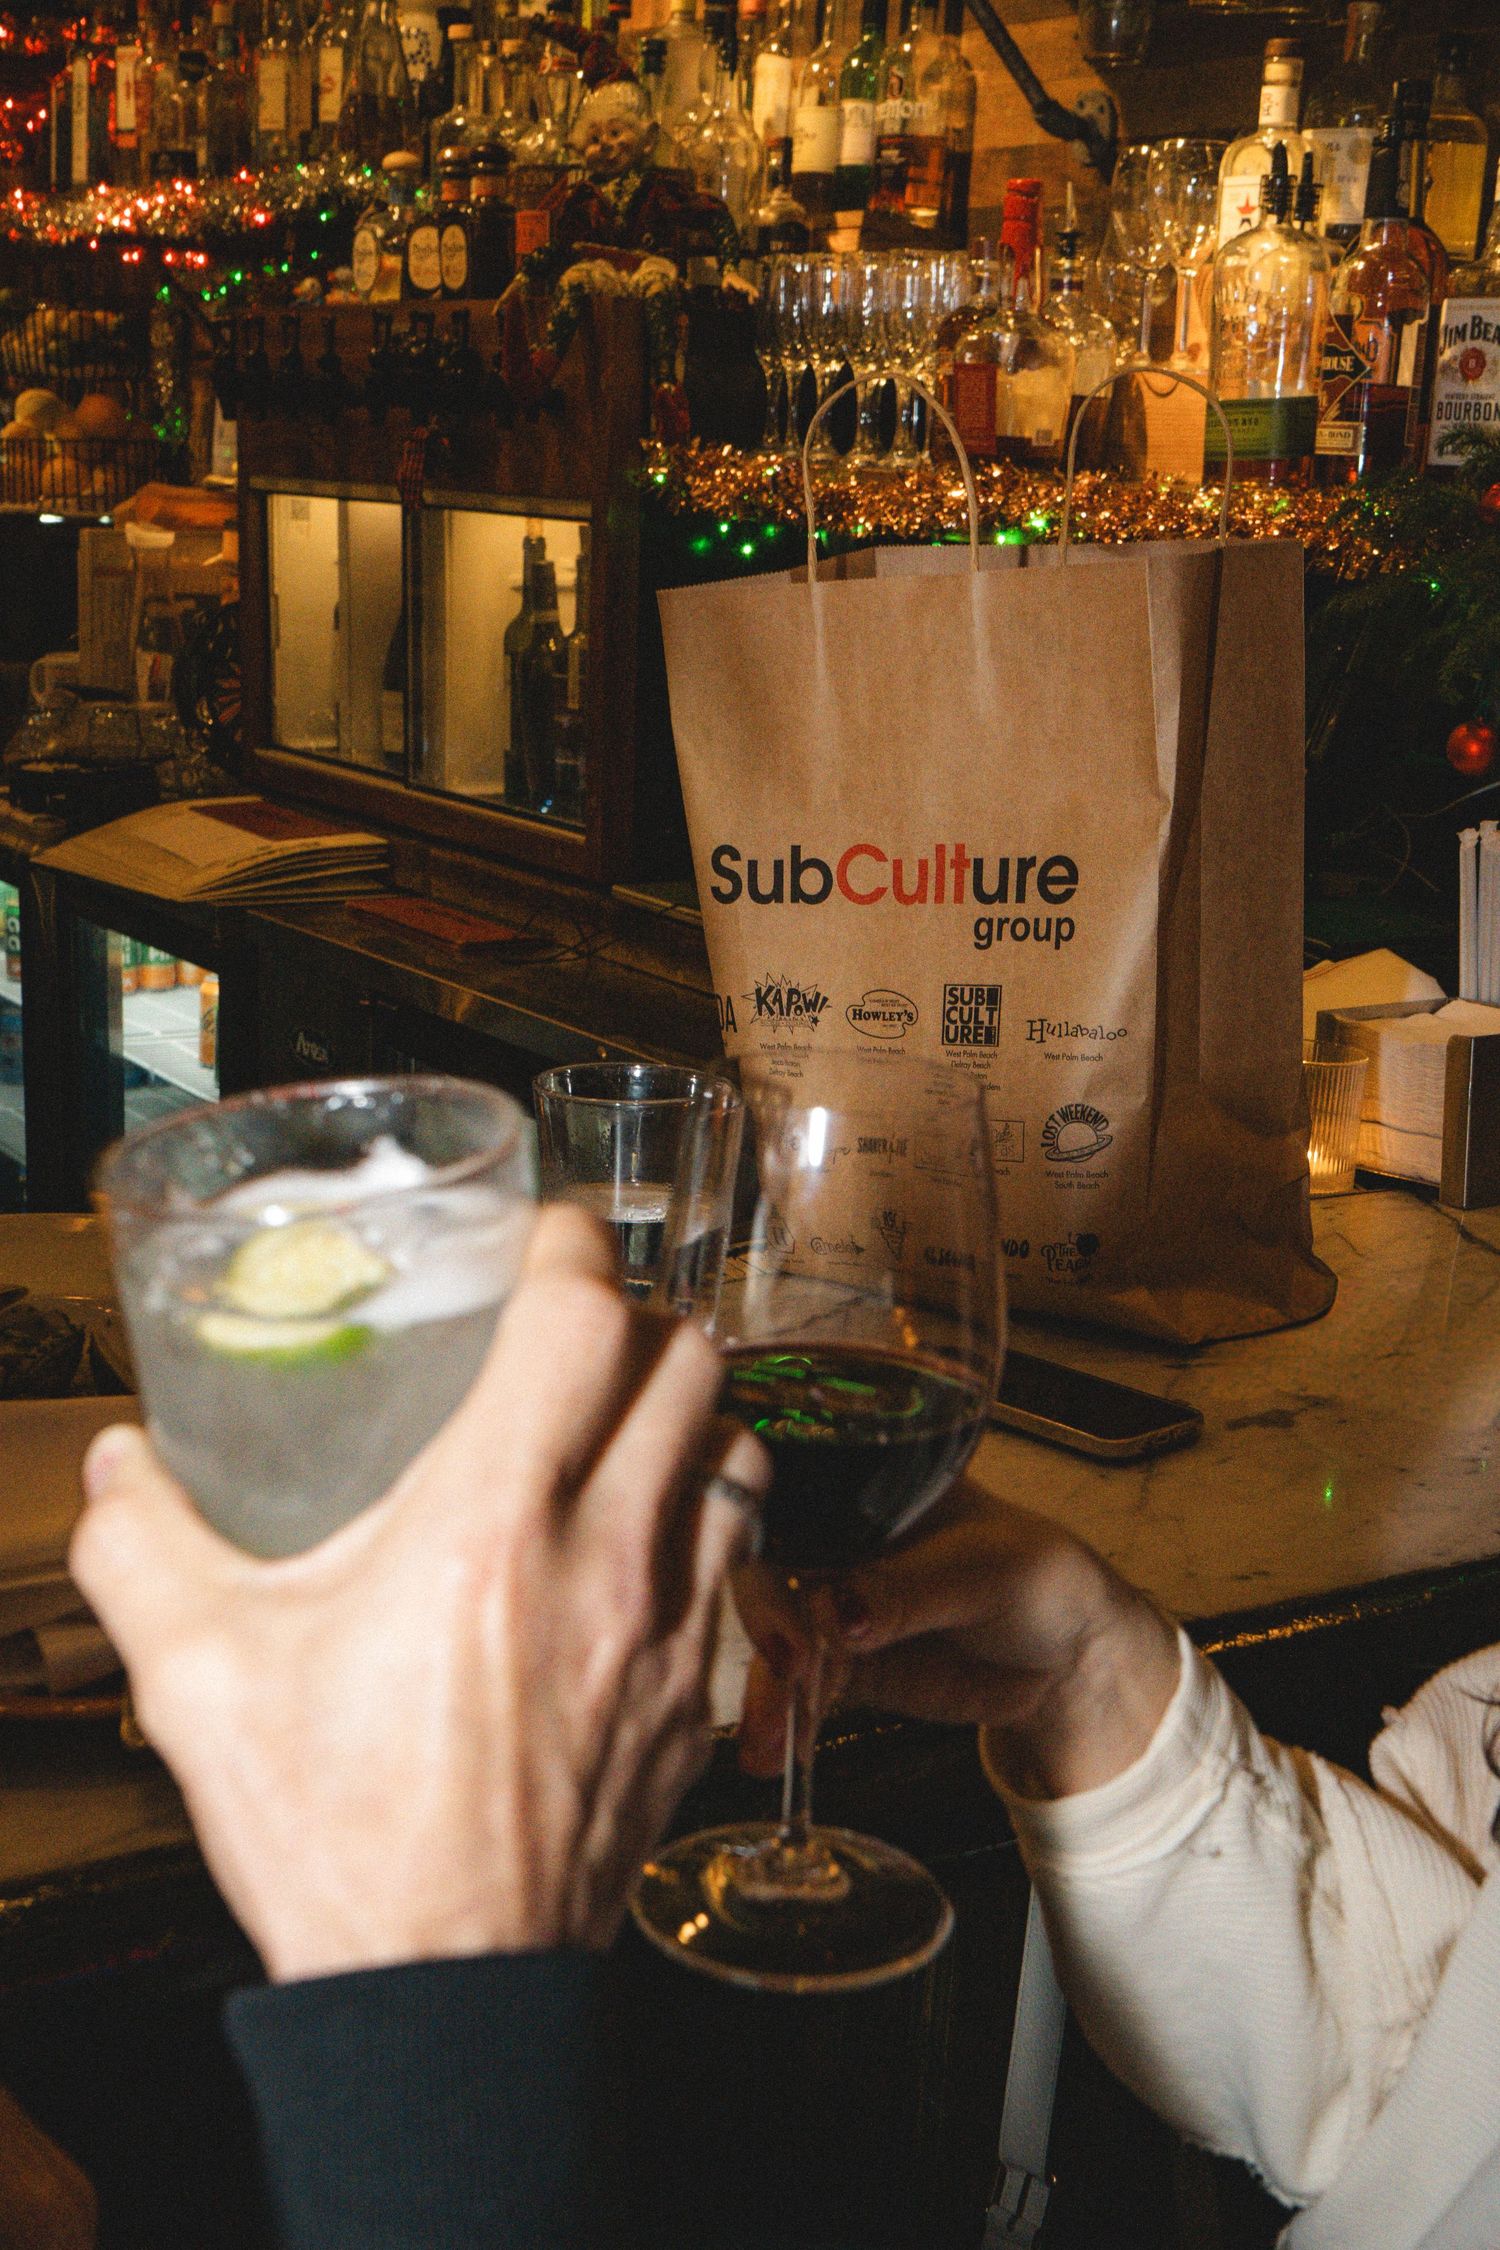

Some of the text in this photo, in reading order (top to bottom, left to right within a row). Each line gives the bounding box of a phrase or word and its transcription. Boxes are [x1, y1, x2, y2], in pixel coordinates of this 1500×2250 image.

[1440, 322, 1468, 356] JIM
[710, 843, 1080, 906] SubCulture
[973, 916, 1076, 950] group
[755, 984, 829, 1017] KAPOW!
[947, 987, 985, 1006] SUB
[852, 1008, 914, 1022] HOWLEY'S
[946, 1006, 998, 1026] CULT
[944, 1025, 984, 1045] URE
[1025, 1018, 1128, 1044] Hullabaloo
[760, 1042, 813, 1051] West Palm Beach
[946, 1050, 998, 1060] West Palm Beach
[951, 1061, 991, 1071] Delray Beach
[1044, 1052, 1104, 1062] West Palm Beach
[1041, 1103, 1109, 1148] LOST WEEKEND
[1045, 1169, 1109, 1179] West Palm Beach
[1054, 1180, 1100, 1191] South Beach
